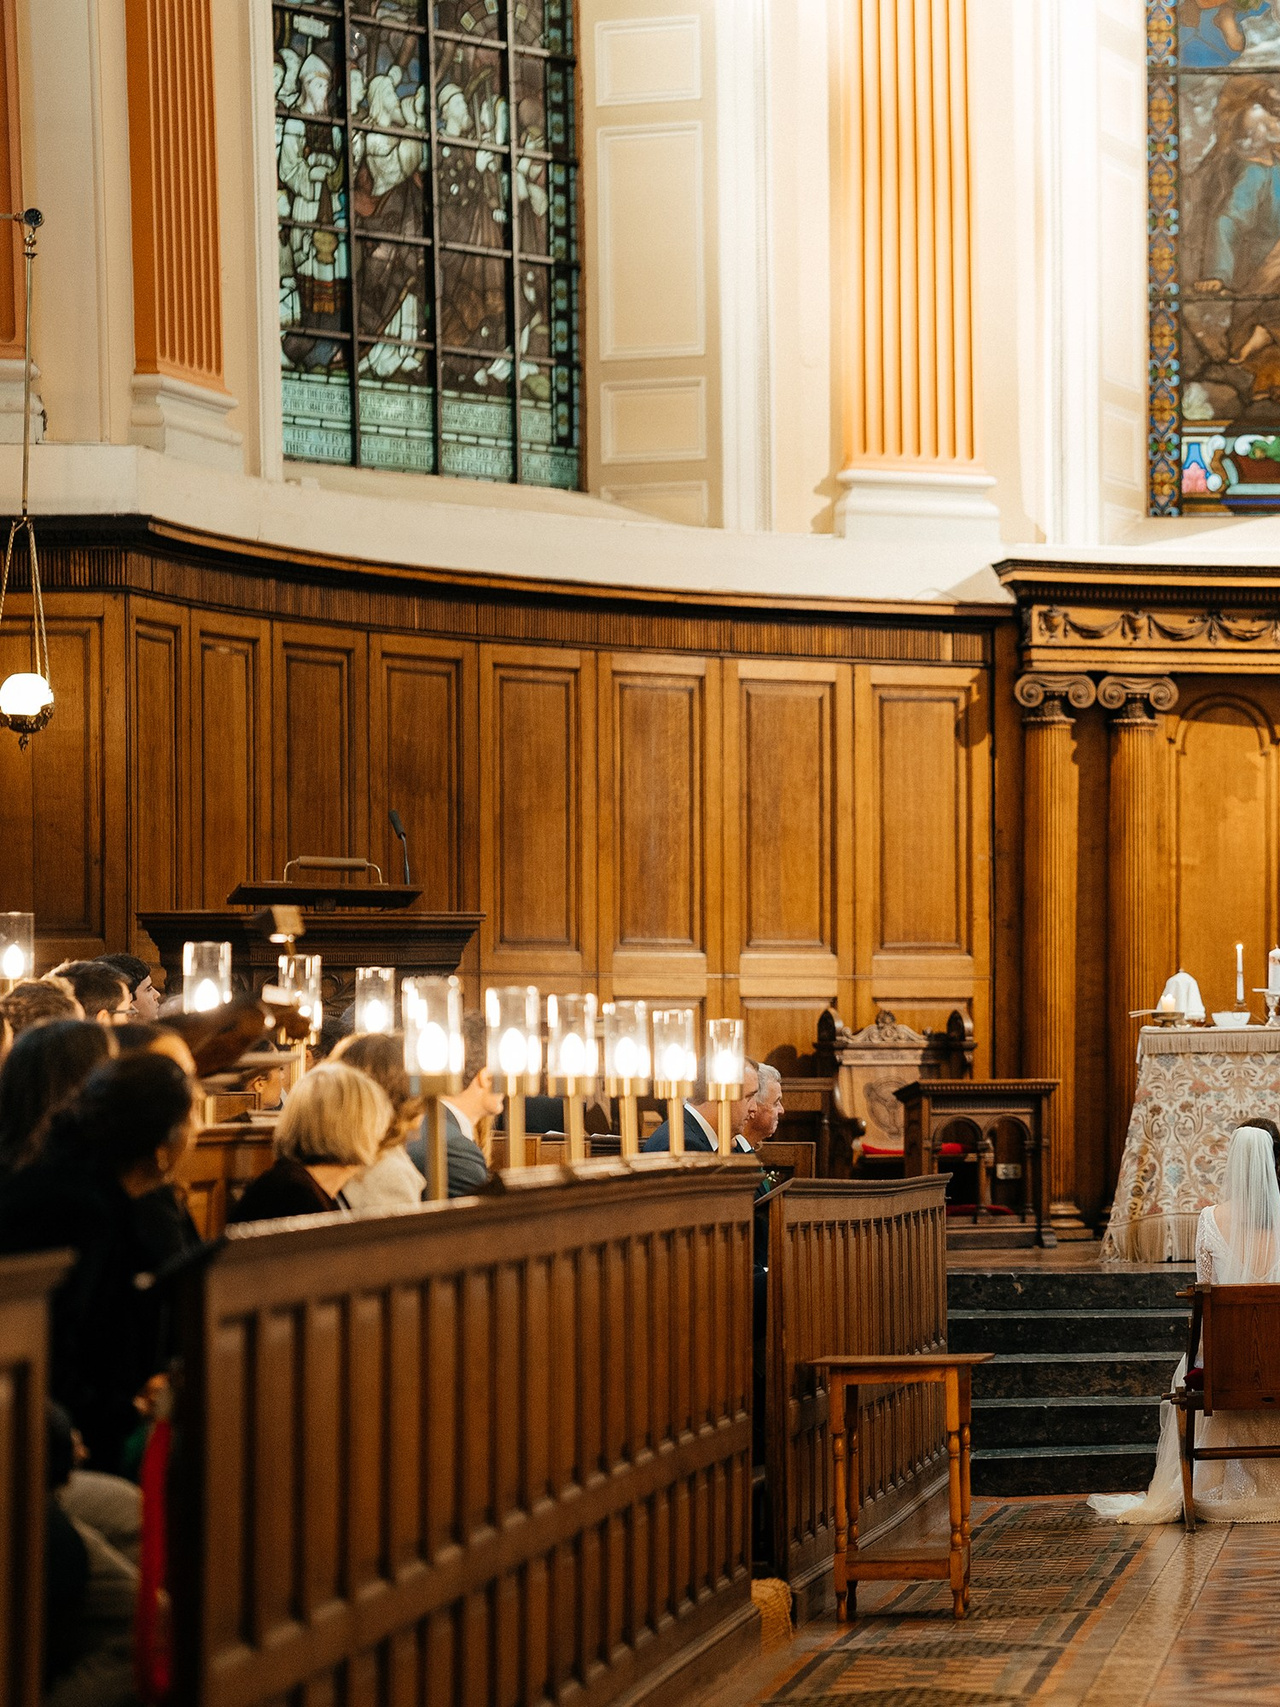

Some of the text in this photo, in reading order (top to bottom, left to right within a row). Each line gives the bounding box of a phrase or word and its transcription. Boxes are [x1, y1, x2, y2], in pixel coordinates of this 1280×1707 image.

[291, 428, 313, 442] THE
[318, 431, 345, 447] VERY
[285, 441, 304, 454] THIS
[308, 445, 350, 459] COLLEGE
